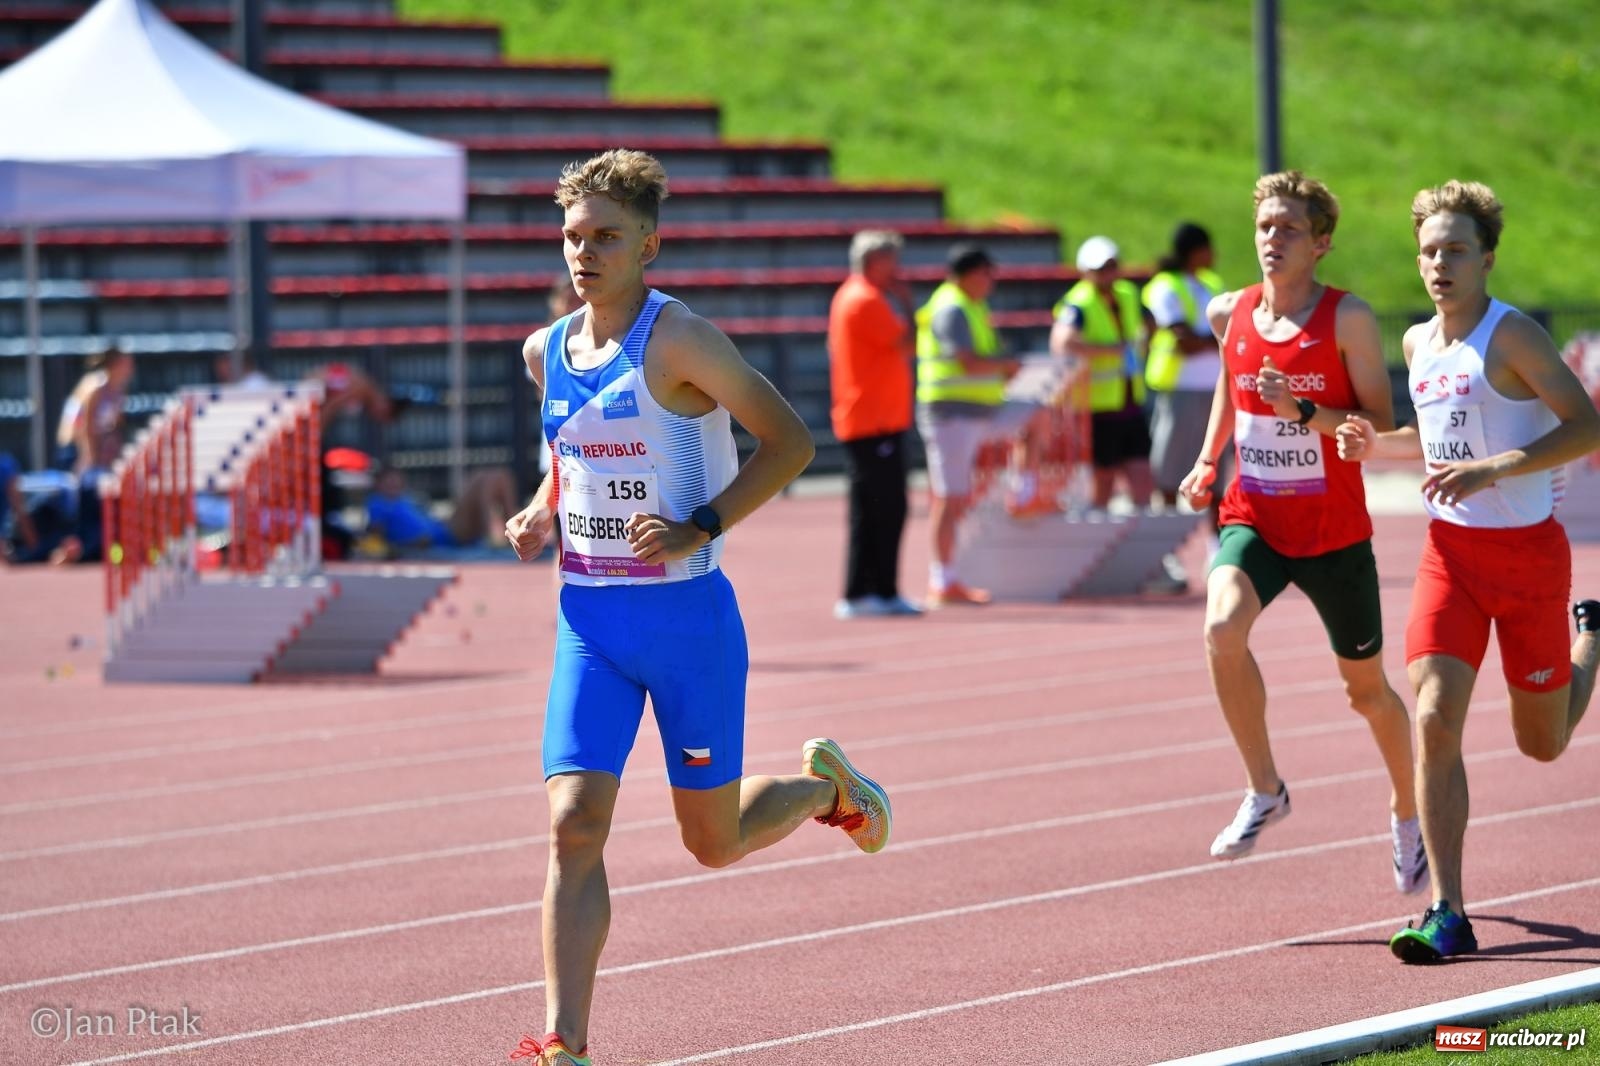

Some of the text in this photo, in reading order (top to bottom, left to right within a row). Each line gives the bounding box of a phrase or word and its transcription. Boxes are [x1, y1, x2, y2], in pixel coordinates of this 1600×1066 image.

[1450, 411, 1467, 427] 57
[583, 441, 647, 458] REPUBLIC
[1240, 446, 1318, 468] GORENFLO
[1427, 441, 1474, 460] RULKA
[607, 480, 647, 500] 158
[1525, 668, 1555, 684] 4F
